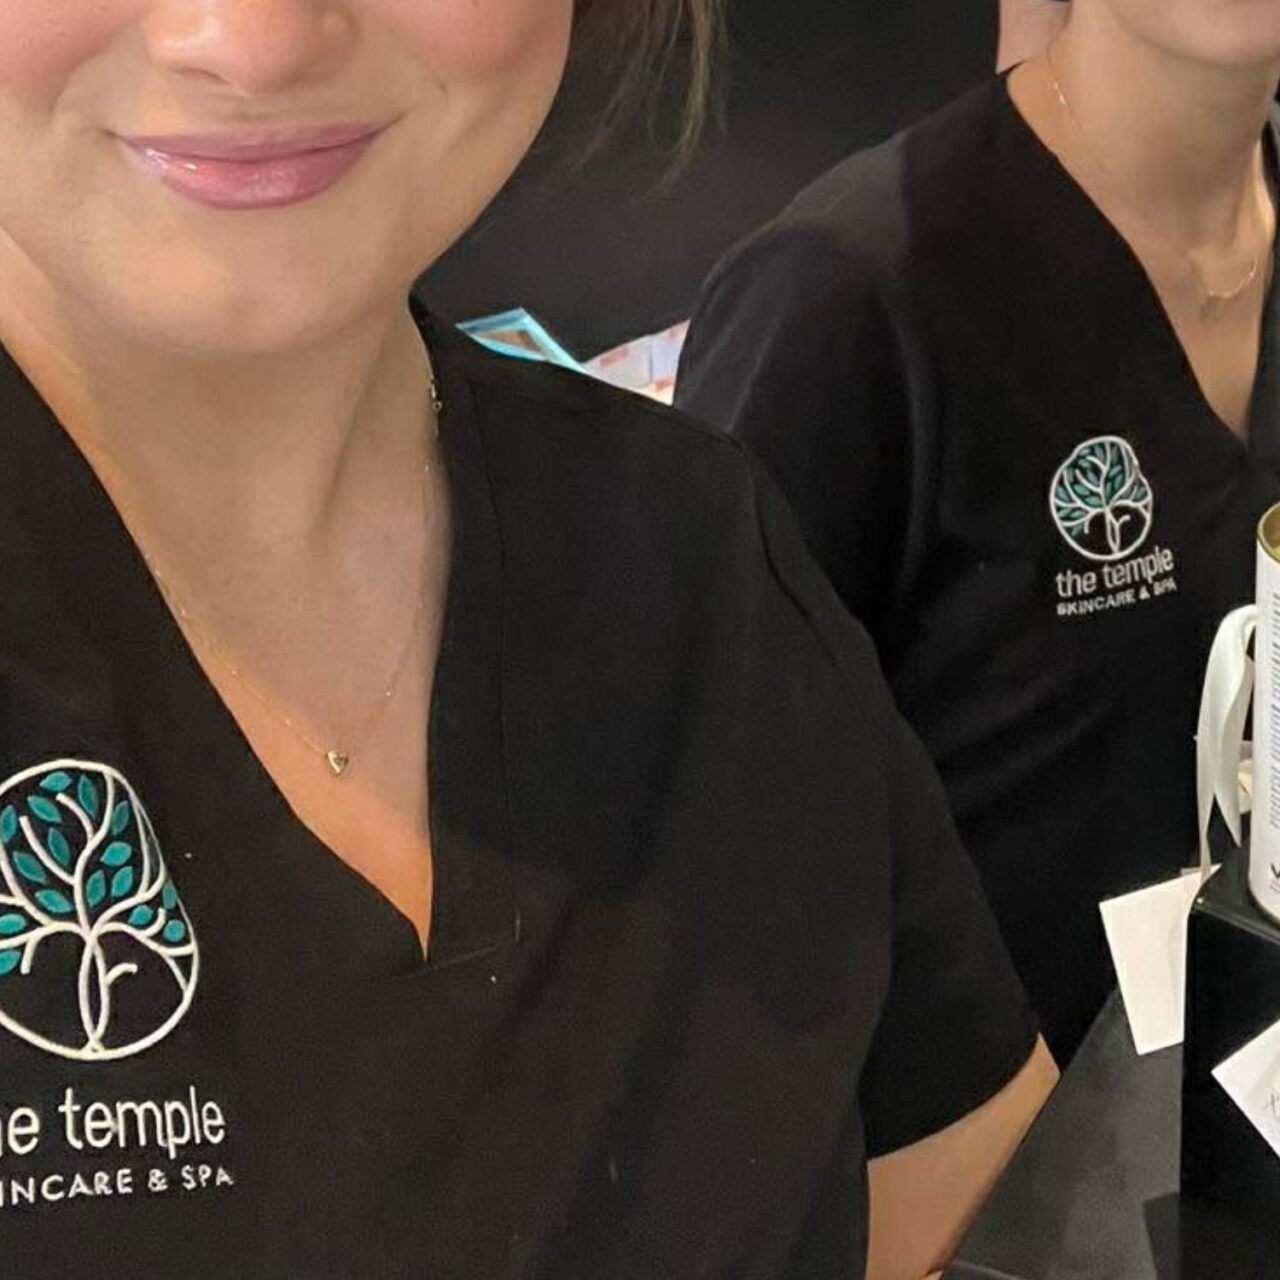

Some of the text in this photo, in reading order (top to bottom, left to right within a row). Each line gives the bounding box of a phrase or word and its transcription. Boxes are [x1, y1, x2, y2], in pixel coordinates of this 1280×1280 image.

[1055, 545, 1175, 598] the temple
[1056, 577, 1178, 617] SKINCARE & SPA
[58, 1084, 227, 1161] temple
[0, 1164, 236, 1208] INCARE & SPA
